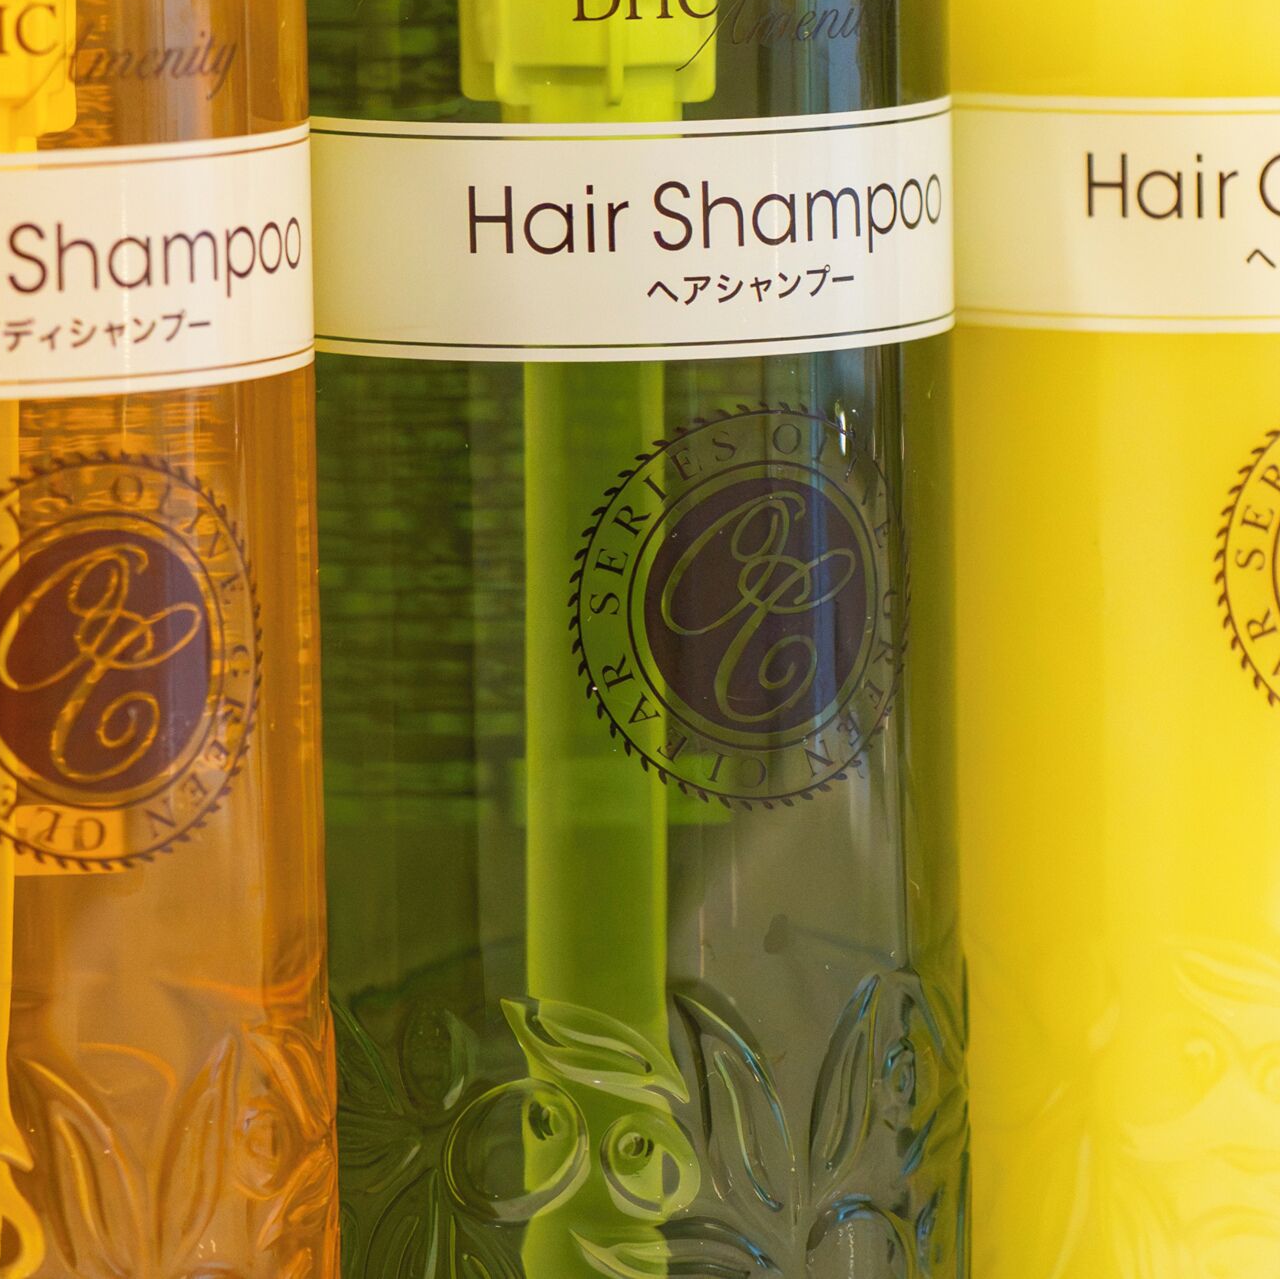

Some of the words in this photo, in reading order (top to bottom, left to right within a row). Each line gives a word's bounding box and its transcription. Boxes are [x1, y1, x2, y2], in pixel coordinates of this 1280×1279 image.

[12, 24, 237, 110] Amenity
[467, 184, 629, 256] Hair
[652, 173, 942, 254] Shampoo
[1085, 150, 1239, 220] Hair
[7, 216, 302, 297] Shampoo
[646, 264, 856, 306] ヘアシャンプー
[589, 429, 738, 617] SERIES
